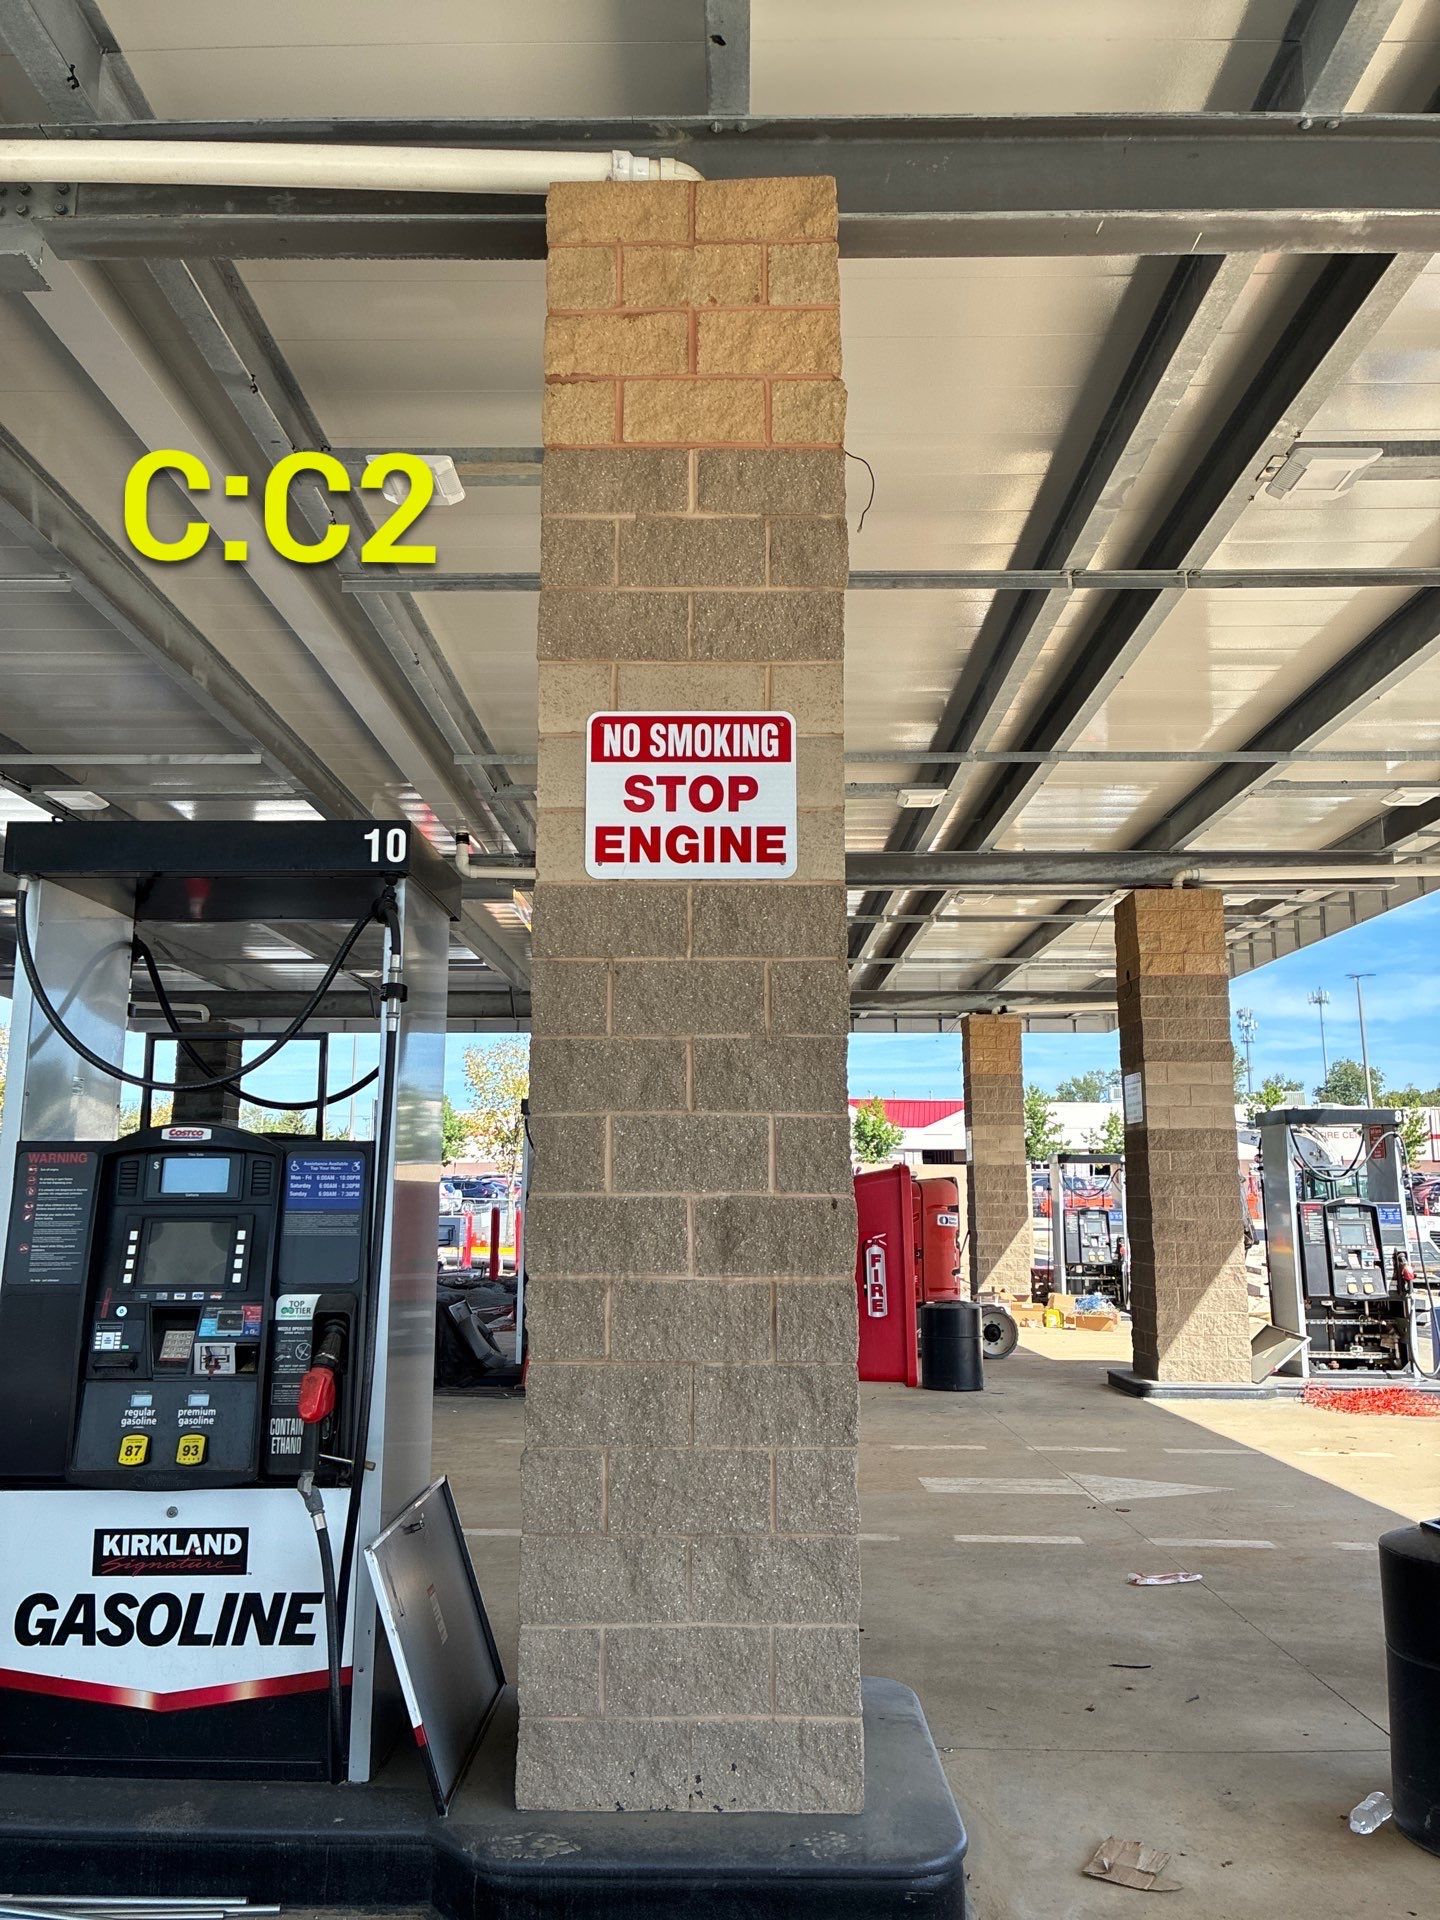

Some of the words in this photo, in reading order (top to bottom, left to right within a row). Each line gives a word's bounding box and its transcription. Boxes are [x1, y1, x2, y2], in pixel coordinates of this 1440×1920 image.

[603, 723, 641, 757] NO
[649, 723, 779, 757] SMOKING
[623, 774, 759, 813] STOP
[364, 828, 407, 863] 10
[595, 825, 787, 864] ENGINE
[1394, 1110, 1402, 1122] 8
[169, 1128, 204, 1136] COSTCO
[28, 1152, 88, 1164] WARNING
[153, 1161, 160, 1170] $
[870, 1253, 884, 1313] FIRE
[124, 1407, 156, 1418] regular
[178, 1407, 216, 1418] premium
[120, 1416, 157, 1428] gasoline
[178, 1416, 214, 1428] gasoline
[124, 1445, 142, 1456] 87
[182, 1445, 199, 1456] 93
[271, 1436, 302, 1454] ETHANO
[102, 1533, 242, 1556] KIRKLAND
[100, 1556, 242, 1577] Signature
[14, 1592, 325, 1648] GASOLINE
